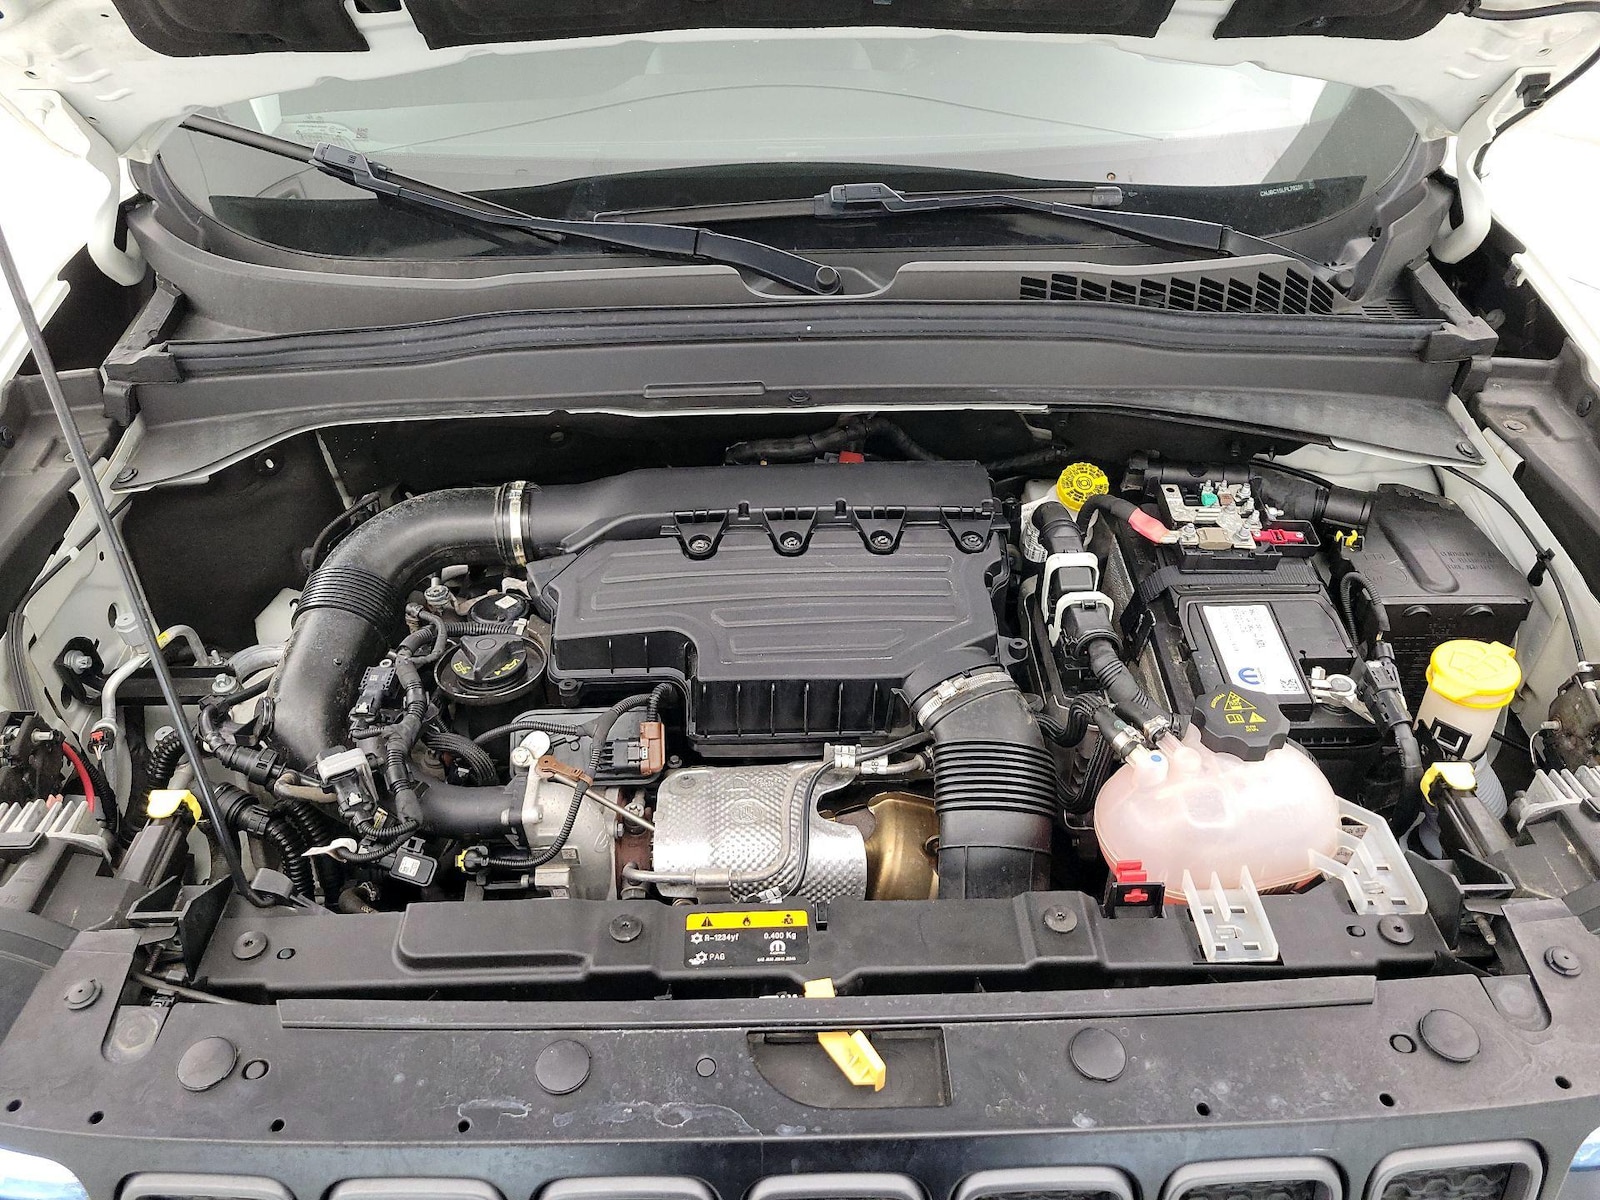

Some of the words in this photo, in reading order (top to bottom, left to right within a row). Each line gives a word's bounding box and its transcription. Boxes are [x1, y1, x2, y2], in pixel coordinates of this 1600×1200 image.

[704, 933, 740, 942] R-1234yf
[763, 932, 785, 940] 0.400
[786, 931, 797, 941] Kg
[709, 952, 726, 961] PAG
